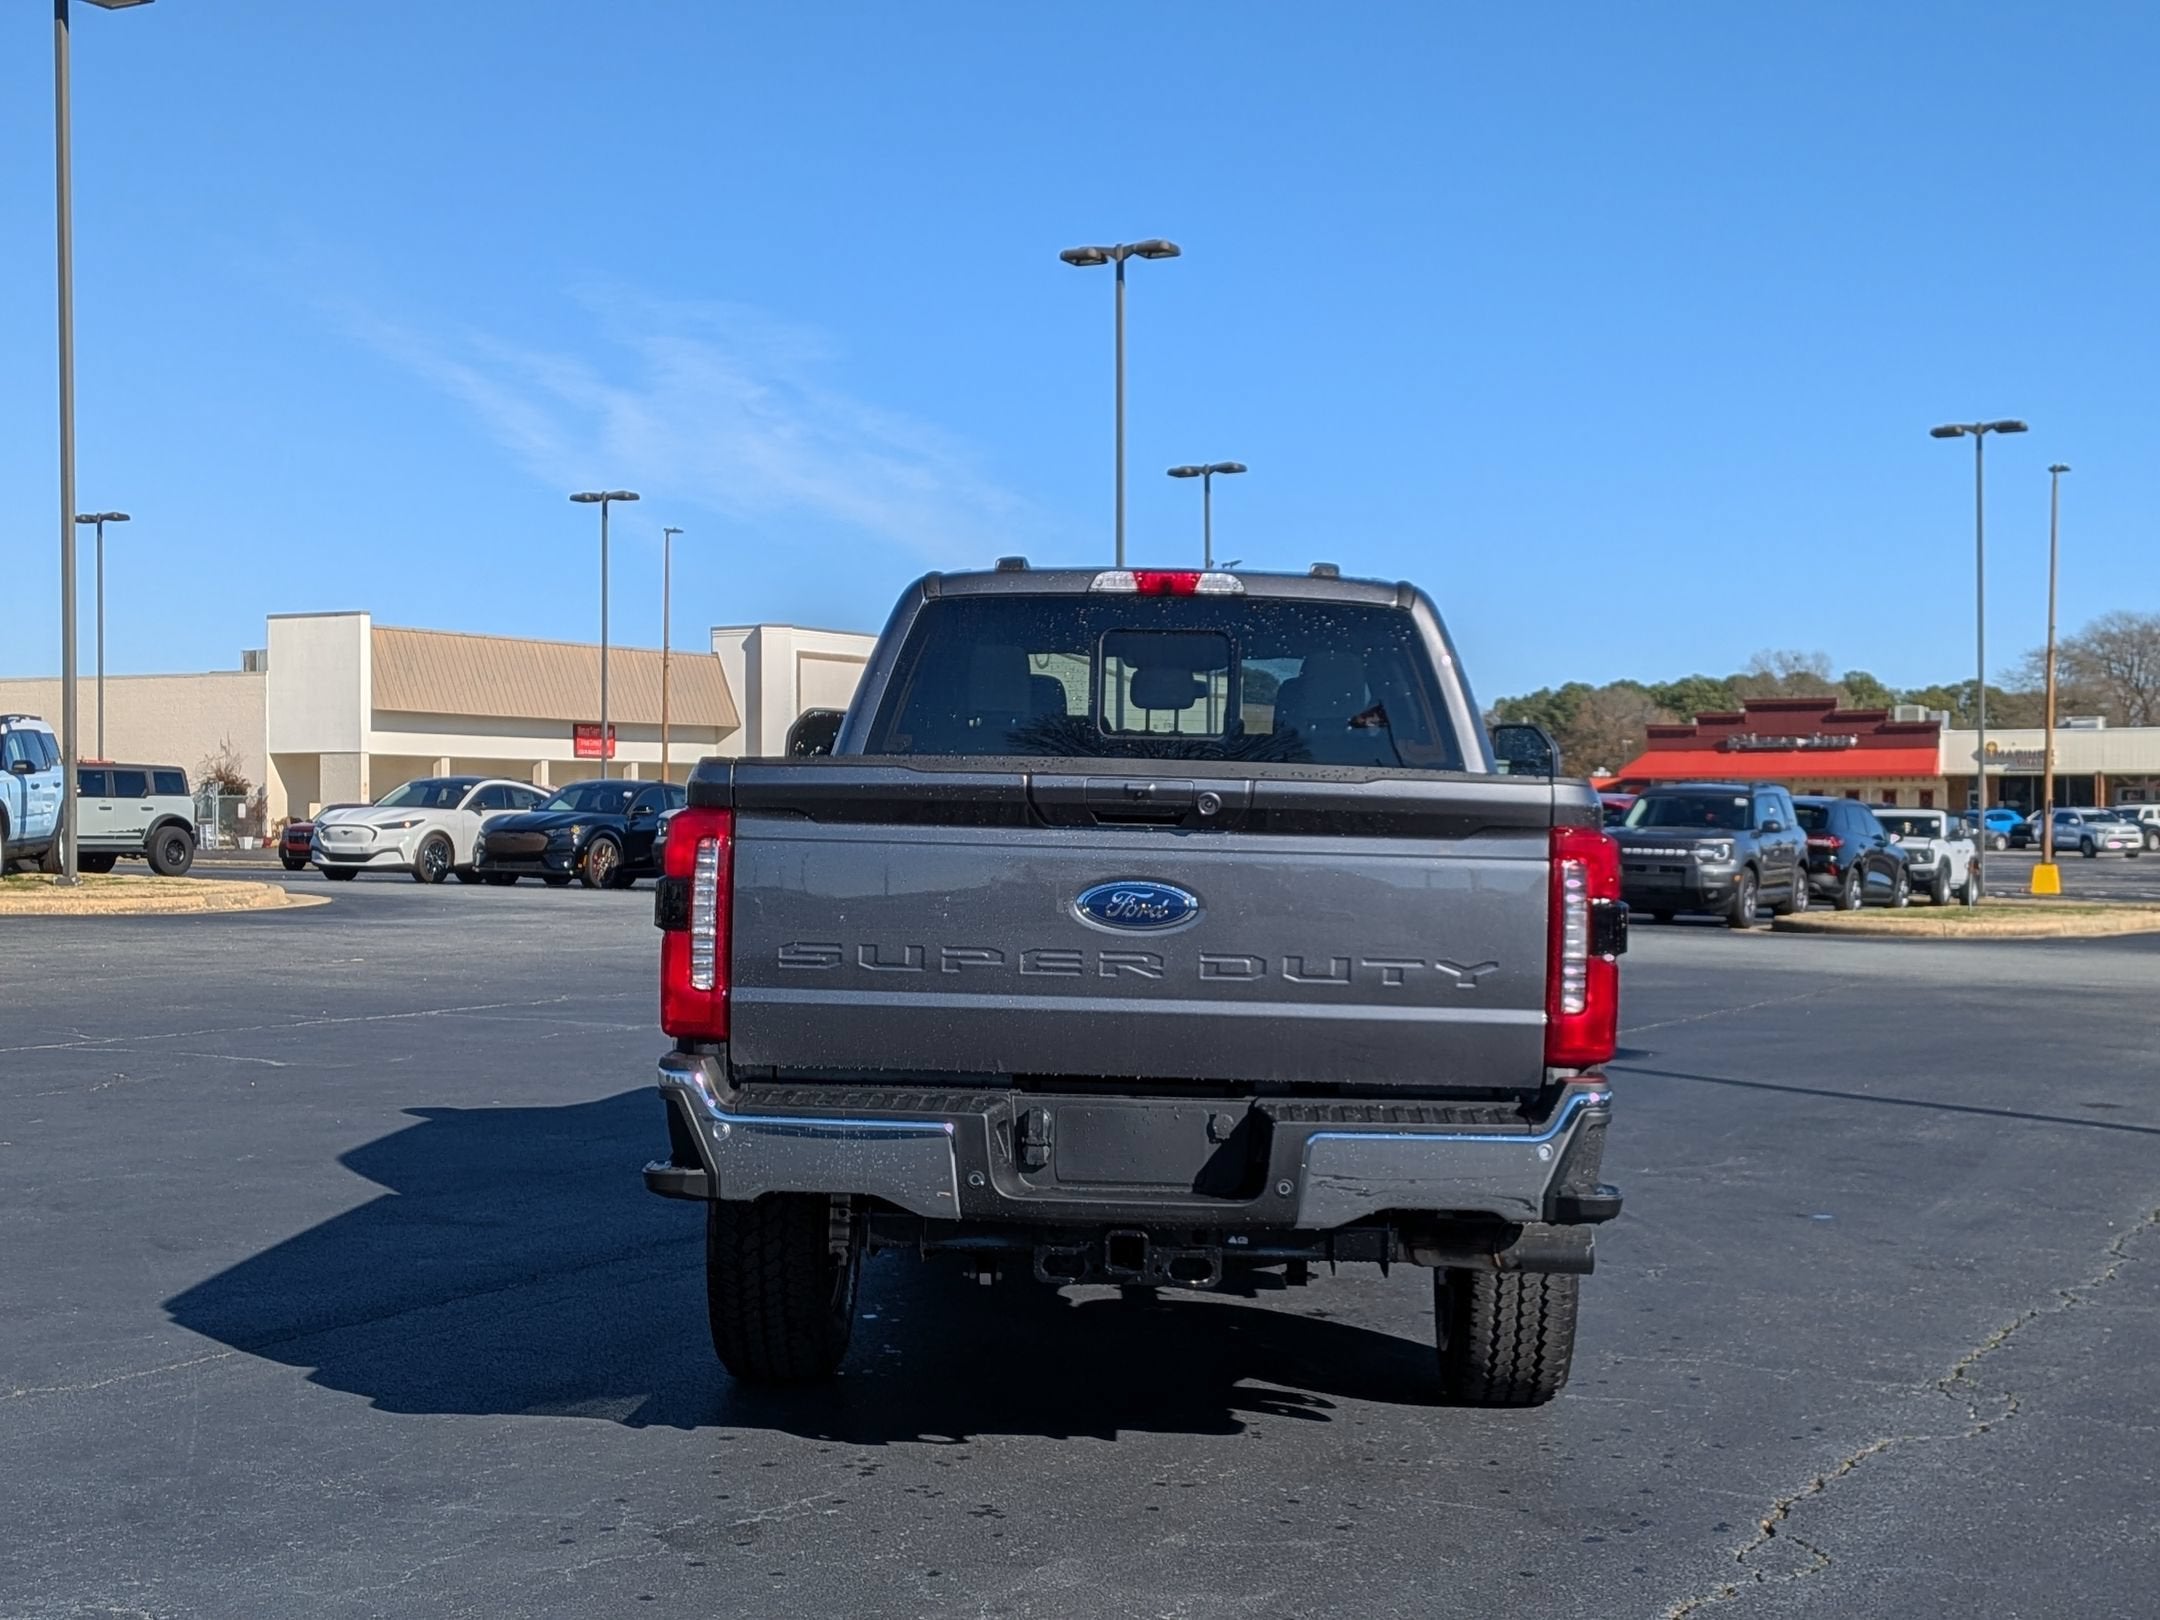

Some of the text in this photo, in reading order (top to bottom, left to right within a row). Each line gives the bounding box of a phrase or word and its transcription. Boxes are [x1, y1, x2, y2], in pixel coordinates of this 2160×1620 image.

[1105, 890, 1170, 919] Ford
[778, 941, 1499, 988] SUPER DUTY
